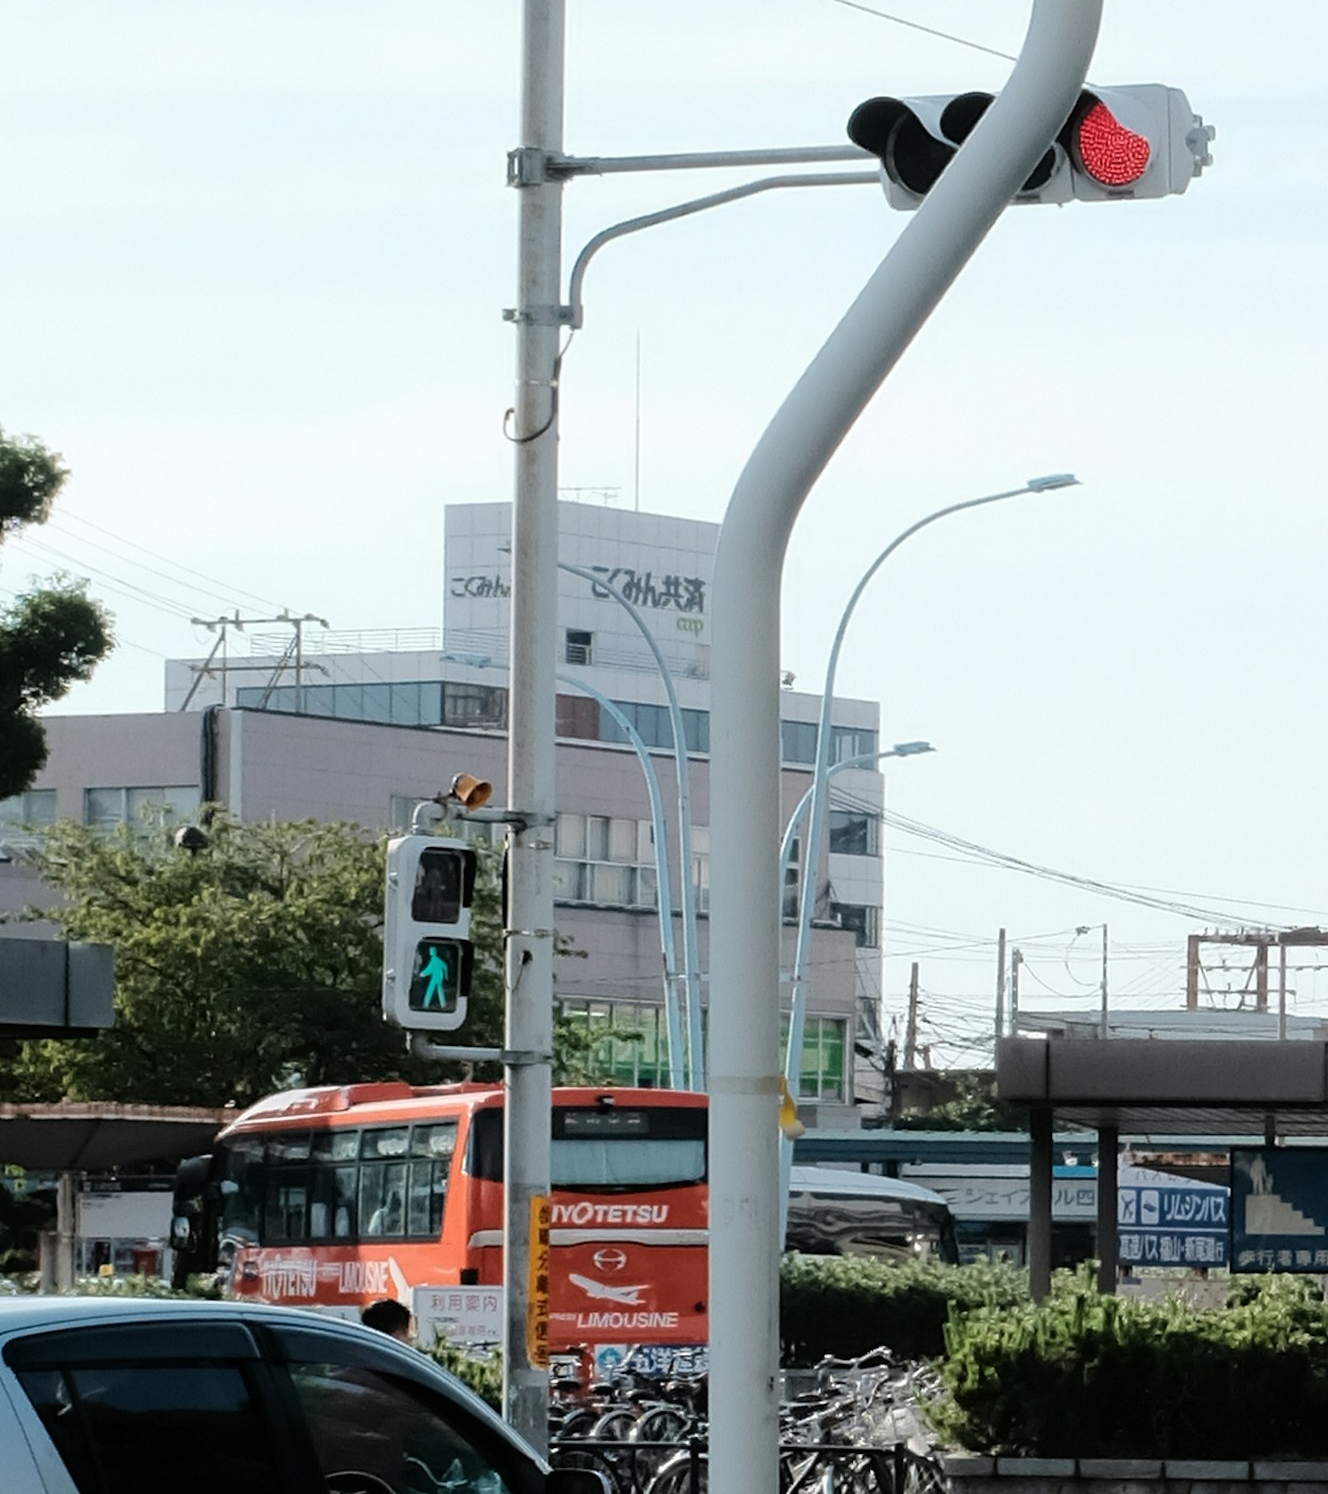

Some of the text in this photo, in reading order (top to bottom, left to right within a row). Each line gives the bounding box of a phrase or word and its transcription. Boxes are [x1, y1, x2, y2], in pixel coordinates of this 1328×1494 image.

[551, 1201, 670, 1225] IYOTETSU
[1163, 1193, 1227, 1222] リムジンバス
[431, 1294, 498, 1313] 利用案内
[576, 1311, 679, 1329] LIMOUSINE
